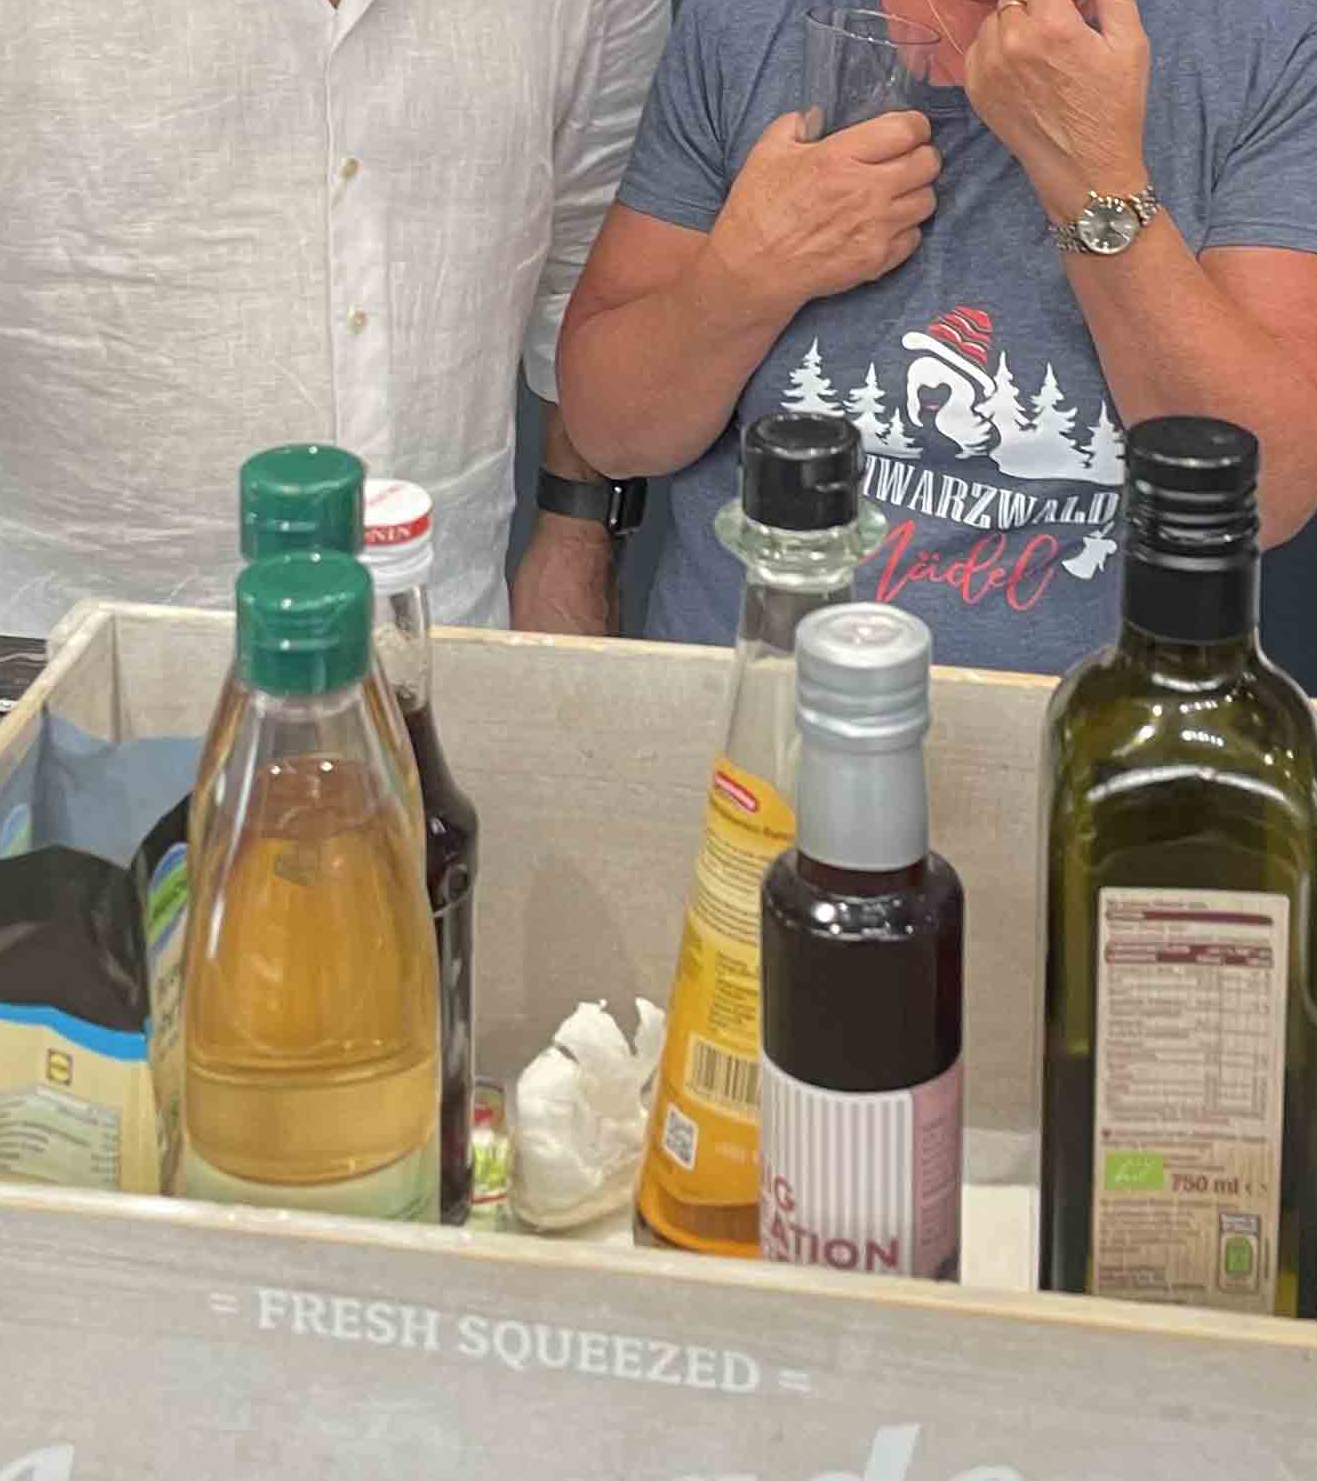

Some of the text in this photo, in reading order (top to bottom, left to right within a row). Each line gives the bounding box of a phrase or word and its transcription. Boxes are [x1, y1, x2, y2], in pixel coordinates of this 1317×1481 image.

[864, 454, 1120, 533] WARZWALD
[1171, 1172, 1209, 1193] 750
[256, 1286, 762, 1396] FRESH SQUEEZED
